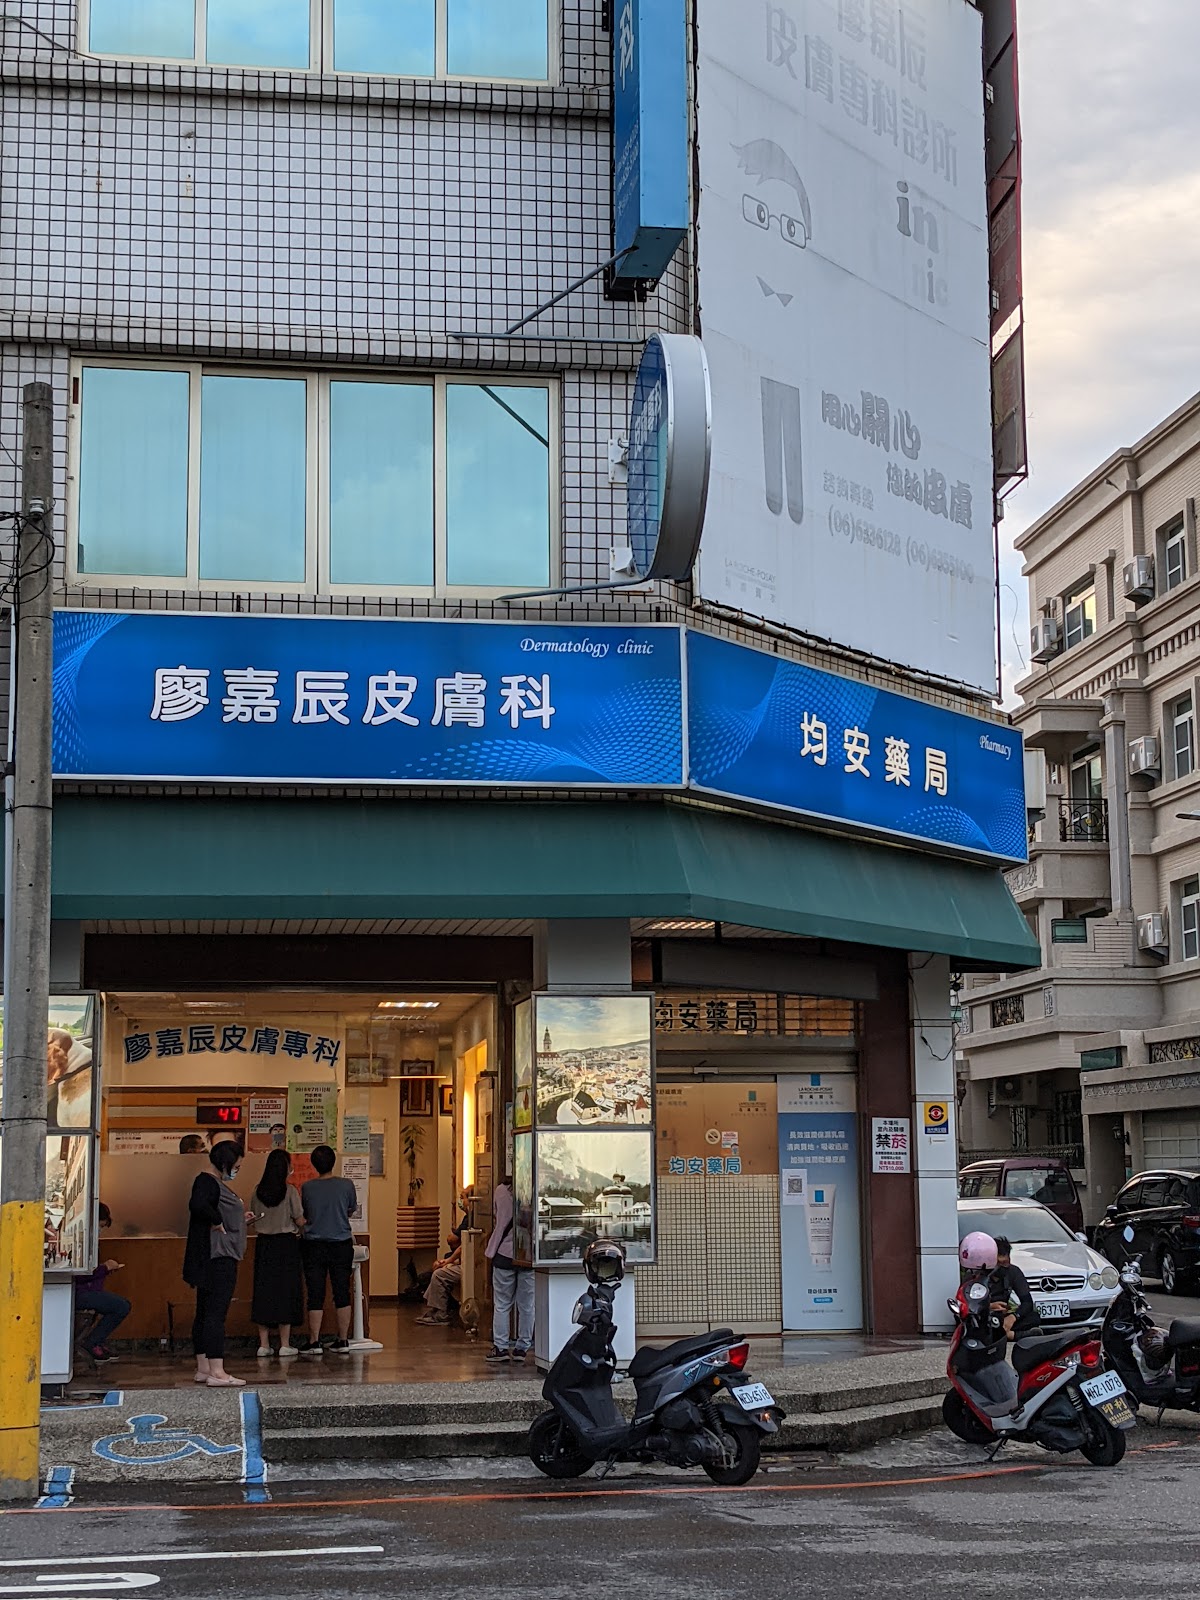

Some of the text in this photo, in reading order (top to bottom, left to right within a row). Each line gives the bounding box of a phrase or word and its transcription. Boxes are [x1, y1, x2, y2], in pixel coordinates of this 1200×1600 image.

[520, 637, 654, 658] Dermatology clinic
[149, 664, 556, 730] 廖嘉辰皮膚科
[800, 711, 948, 796] 均安藥局
[979, 734, 1012, 760] Pharmacy
[123, 1023, 342, 1068] 廖嘉辰皮膚專科
[218, 1107, 240, 1121] 47
[875, 1133, 907, 1150] 禁菸
[669, 1157, 742, 1175] 均安藥局
